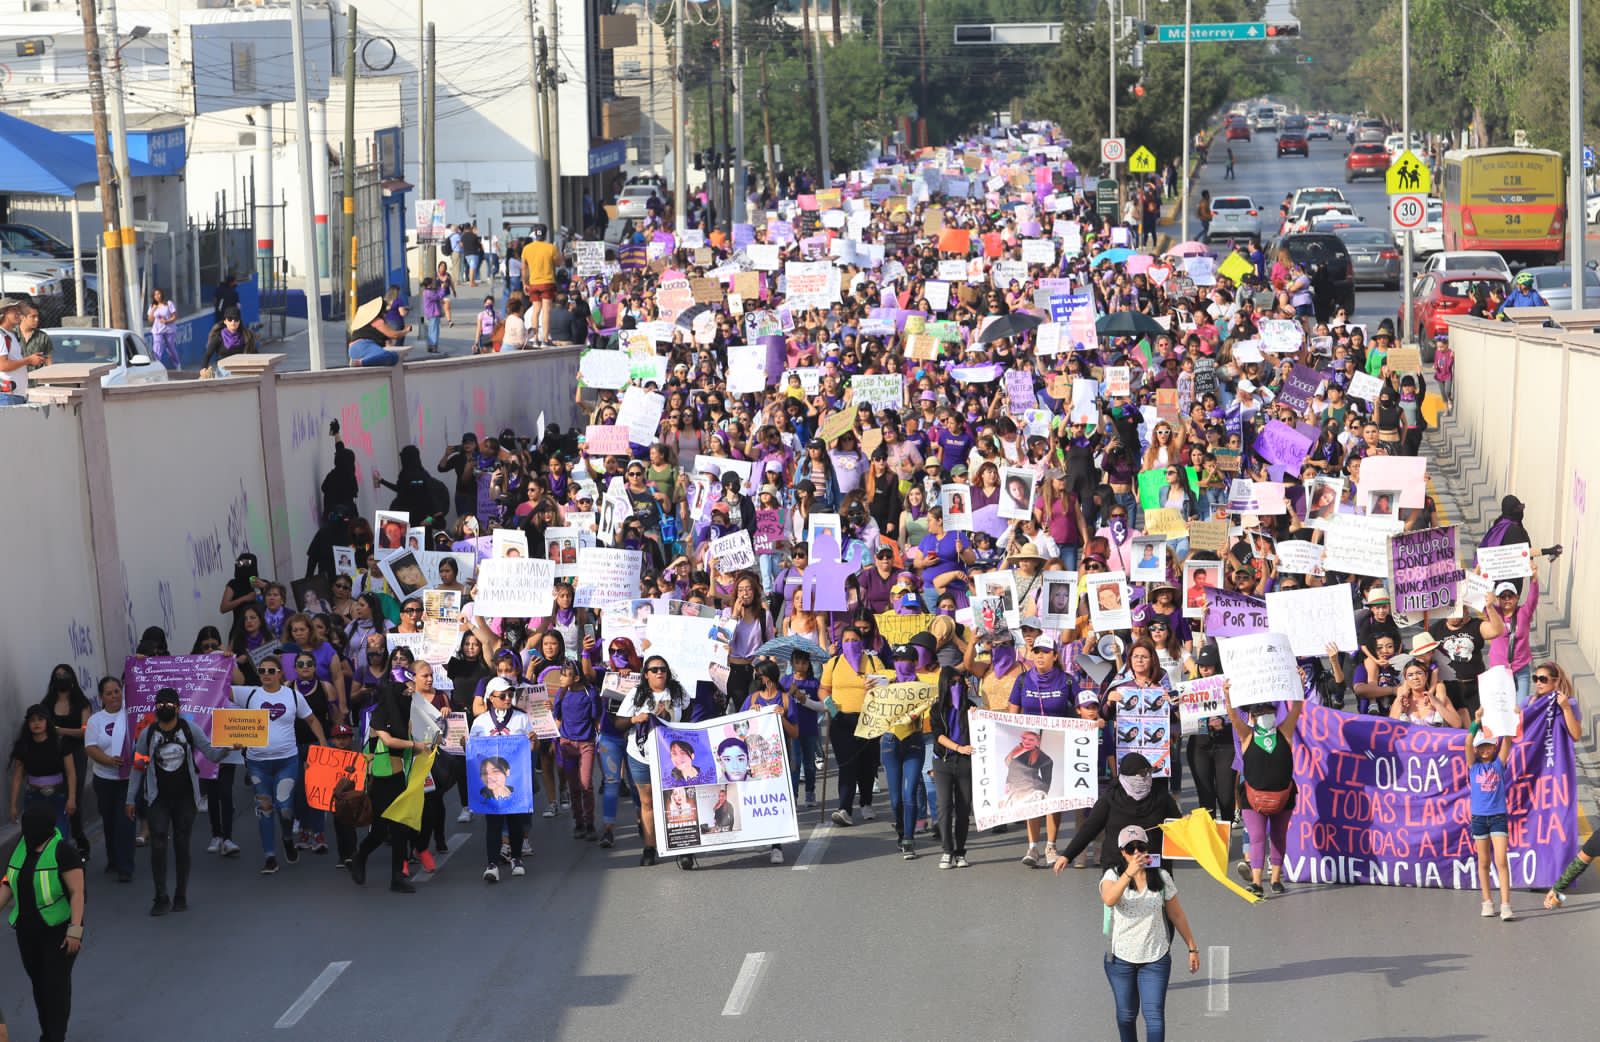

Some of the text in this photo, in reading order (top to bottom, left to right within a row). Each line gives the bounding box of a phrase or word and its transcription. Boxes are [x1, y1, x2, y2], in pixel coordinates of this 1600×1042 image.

[1109, 144, 1118, 153] 30
[1402, 202, 1416, 217] 30
[1505, 214, 1521, 225] 34
[1288, 375, 1315, 393] JODER
[1398, 536, 1449, 558] FUTURO
[1397, 547, 1455, 570] DONDE MIS
[1395, 580, 1429, 597] NUNCA
[1429, 569, 1466, 588] TENGAN
[1403, 587, 1450, 610] MIEDO
[1223, 611, 1244, 627] POR
[1191, 676, 1224, 691] SOMO
[874, 687, 916, 701] SOMOS
[1181, 690, 1210, 703] GRITO
[1186, 700, 1218, 713] YA NO
[980, 710, 1012, 724] HERMANA
[977, 724, 991, 808] JUSTICIA
[1074, 736, 1091, 789] OLGA
[1293, 743, 1325, 781] OR
[1331, 750, 1368, 788] TI
[743, 793, 788, 806] NI UNA
[1328, 787, 1397, 824] TODAS
[1405, 795, 1448, 827] LAS
[752, 806, 779, 818] MAS
[1300, 820, 1341, 852] POR
[1342, 825, 1411, 858] TODAS
[1419, 828, 1438, 858] A
[1507, 818, 1530, 850] UE
[1537, 814, 1567, 844] LA
